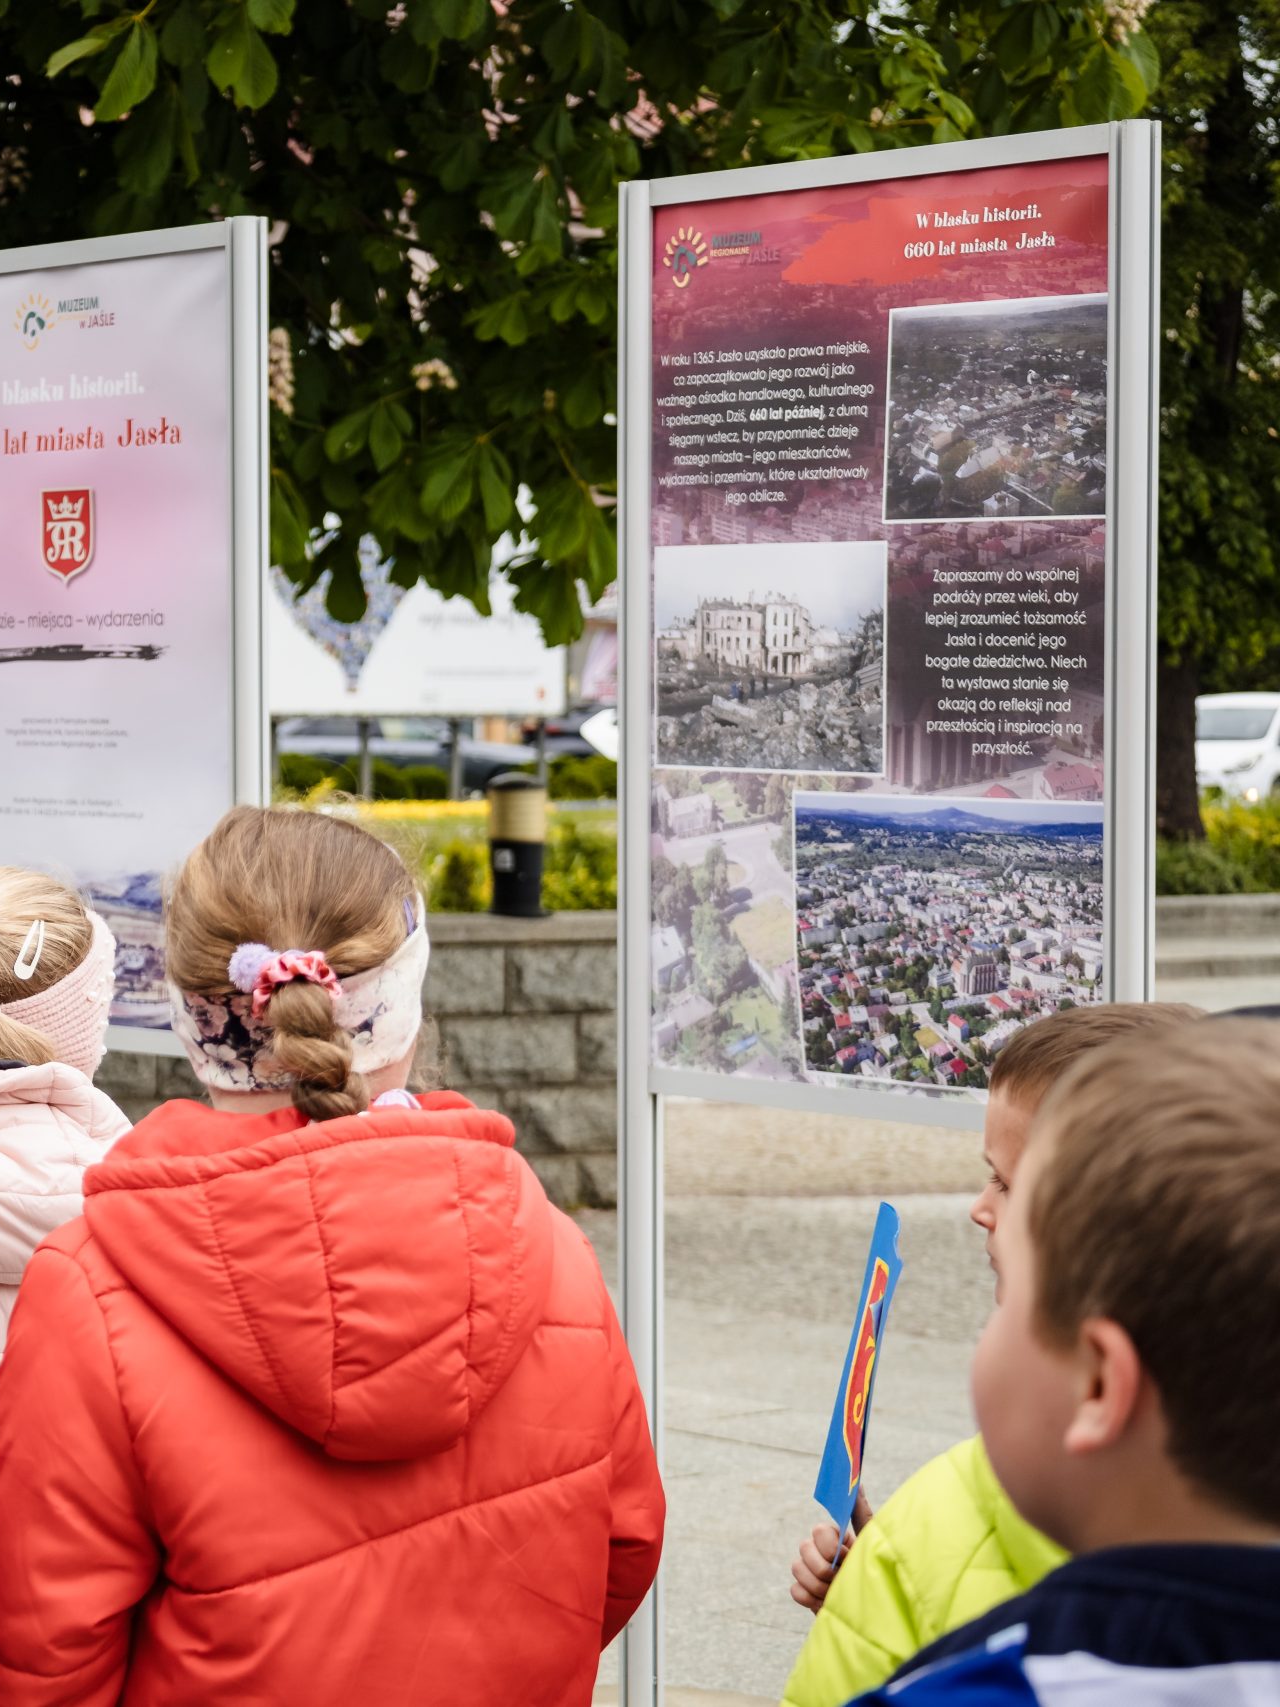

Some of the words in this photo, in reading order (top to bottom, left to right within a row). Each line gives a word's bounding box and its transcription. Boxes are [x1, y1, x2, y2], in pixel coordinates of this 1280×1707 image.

[916, 212, 931, 228] W
[934, 209, 979, 228] blasku
[983, 204, 1042, 224] historii.
[712, 231, 761, 246] MUZEUM
[904, 241, 934, 259] 660
[939, 240, 955, 256] lat
[960, 237, 1007, 254] miasta
[1016, 231, 1055, 249] Jasła
[710, 247, 749, 256] REGIONALNE
[57, 296, 99, 313] MUZEUM
[87, 310, 115, 328] JAŚLE
[661, 356, 669, 366] W
[672, 354, 690, 365] roku
[693, 352, 714, 364] 1365
[716, 349, 743, 363] Jasło
[744, 346, 785, 363] uzyskało
[788, 345, 824, 360] prawa
[827, 341, 869, 357] miejskie,
[674, 376, 685, 386] co
[686, 369, 765, 386] zapoczątkowało
[768, 367, 792, 382] jego
[794, 363, 829, 379] rozwój
[831, 363, 854, 379] jako
[2, 378, 64, 405] blasku
[70, 371, 145, 400] historii.
[657, 392, 696, 408] ważnego
[699, 389, 736, 404] ośrodka
[739, 387, 805, 403] handlowego,
[809, 383, 874, 398] kulturalnego
[727, 409, 747, 424] Dziś,
[749, 408, 767, 421] 660
[769, 407, 783, 420] lat
[785, 405, 827, 422] później,
[828, 406, 835, 416] z
[836, 404, 868, 418] dumą
[4, 429, 28, 455] lat
[36, 425, 104, 452] miasta
[118, 417, 181, 447] Jasła
[669, 431, 705, 448] sięgamy
[707, 431, 740, 443] wstecz,
[743, 429, 754, 443] by
[757, 426, 825, 443] przypomnieć
[828, 424, 858, 440] dzieje
[674, 453, 710, 467] naszego
[712, 450, 743, 463] miasta
[752, 449, 776, 464] jego
[778, 447, 851, 461] mieszkańców,
[659, 472, 708, 488] wydarzenia
[715, 470, 766, 485] przemiany,
[769, 468, 795, 480] które
[798, 466, 868, 480] ukształtowały
[725, 491, 747, 506] jego
[749, 490, 786, 502] oblicze.
[933, 569, 1004, 584] Zapraszamy
[1006, 569, 1023, 581] do
[1025, 567, 1079, 584] wspólnej
[934, 590, 981, 605] podróży
[984, 593, 1015, 605] przez
[1018, 590, 1051, 604] wieki,
[1054, 591, 1078, 605] aby
[28, 611, 72, 632] miejsca
[86, 609, 164, 630] wydarzenia
[926, 612, 958, 627] lepiej
[960, 611, 1020, 625] zrozumieć
[1024, 611, 1087, 625] tożsamość
[945, 633, 975, 647] Jasła
[985, 633, 1035, 647] docenić
[1038, 634, 1066, 649] jego
[926, 655, 970, 670] bogate
[973, 654, 1048, 669] dziedzictwo.
[1051, 655, 1087, 669] Niech
[941, 675, 954, 689] ta
[957, 676, 1009, 691] wystawa
[1013, 677, 1049, 690] stanie
[1052, 678, 1069, 692] się
[938, 697, 976, 713] okazją
[979, 698, 996, 711] do
[999, 698, 1043, 714] refleksji
[1046, 699, 1071, 712] nad
[927, 719, 995, 735] przeszłością
[1004, 719, 1062, 735] inspiracją
[1066, 722, 1082, 734] na
[972, 741, 1033, 756] przyszłość.
